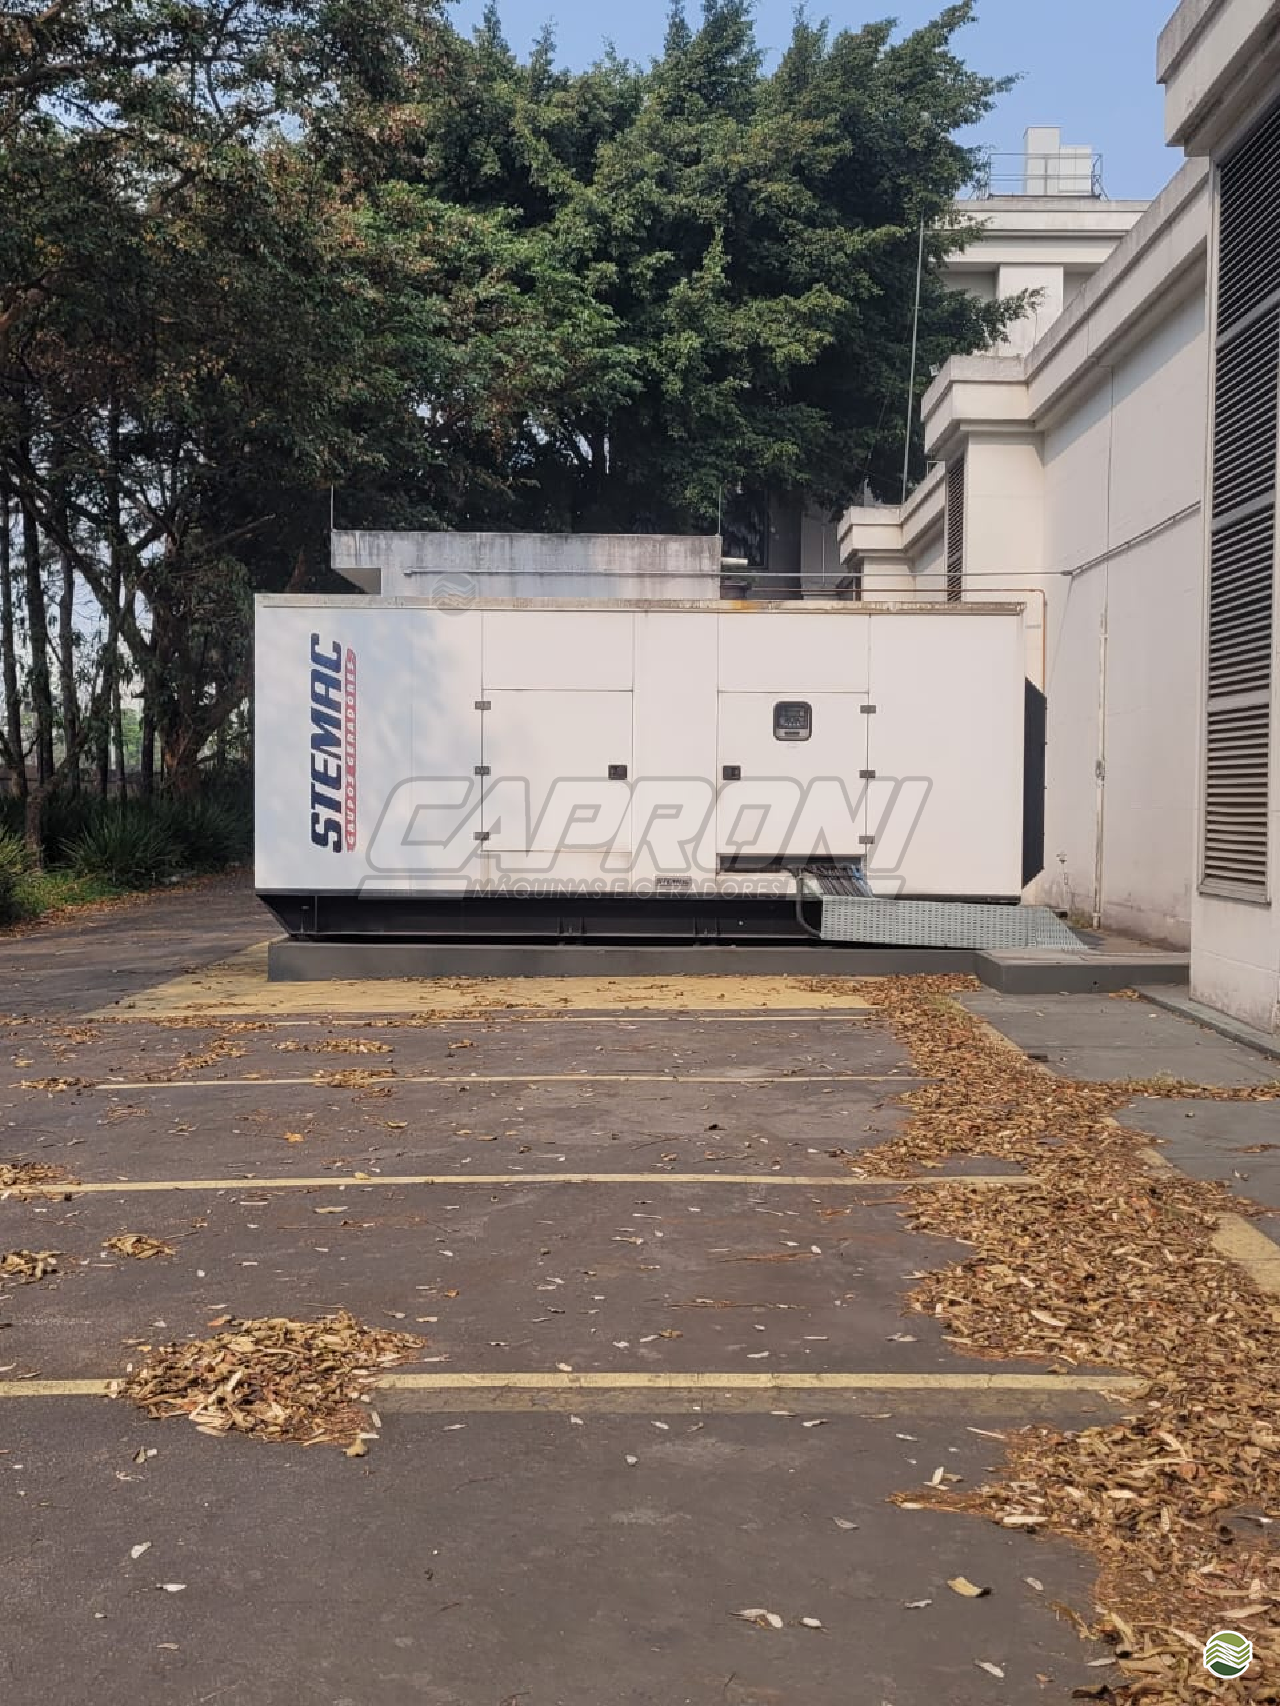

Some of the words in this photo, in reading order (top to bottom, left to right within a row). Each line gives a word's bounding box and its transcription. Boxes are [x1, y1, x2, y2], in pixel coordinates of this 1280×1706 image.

[311, 633, 342, 854] STEMAC
[346, 661, 355, 766] GERADORES
[346, 775, 355, 845] GRUPOS
